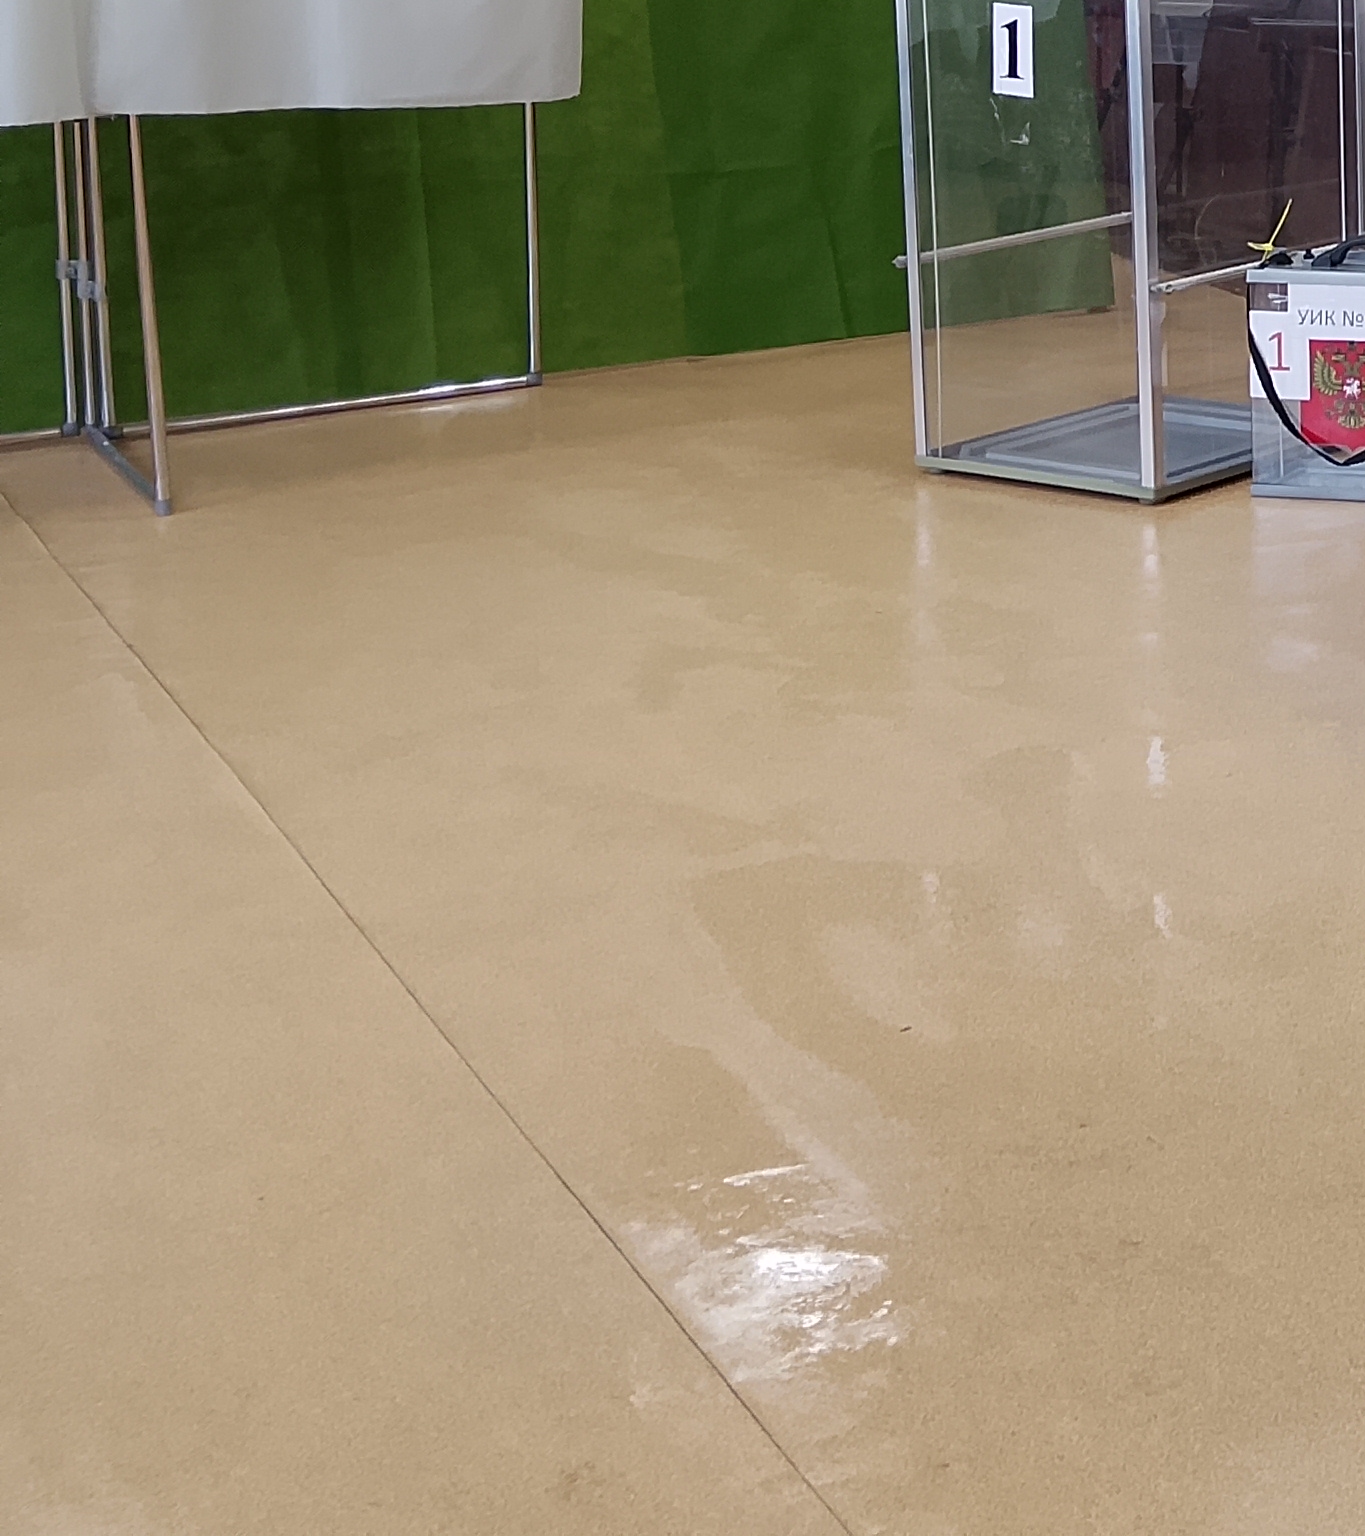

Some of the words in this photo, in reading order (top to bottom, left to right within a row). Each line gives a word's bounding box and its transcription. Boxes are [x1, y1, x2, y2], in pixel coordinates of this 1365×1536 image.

[1000, 18, 1024, 80] 1
[1297, 309, 1336, 326] УИК
[1268, 331, 1291, 372] 1
